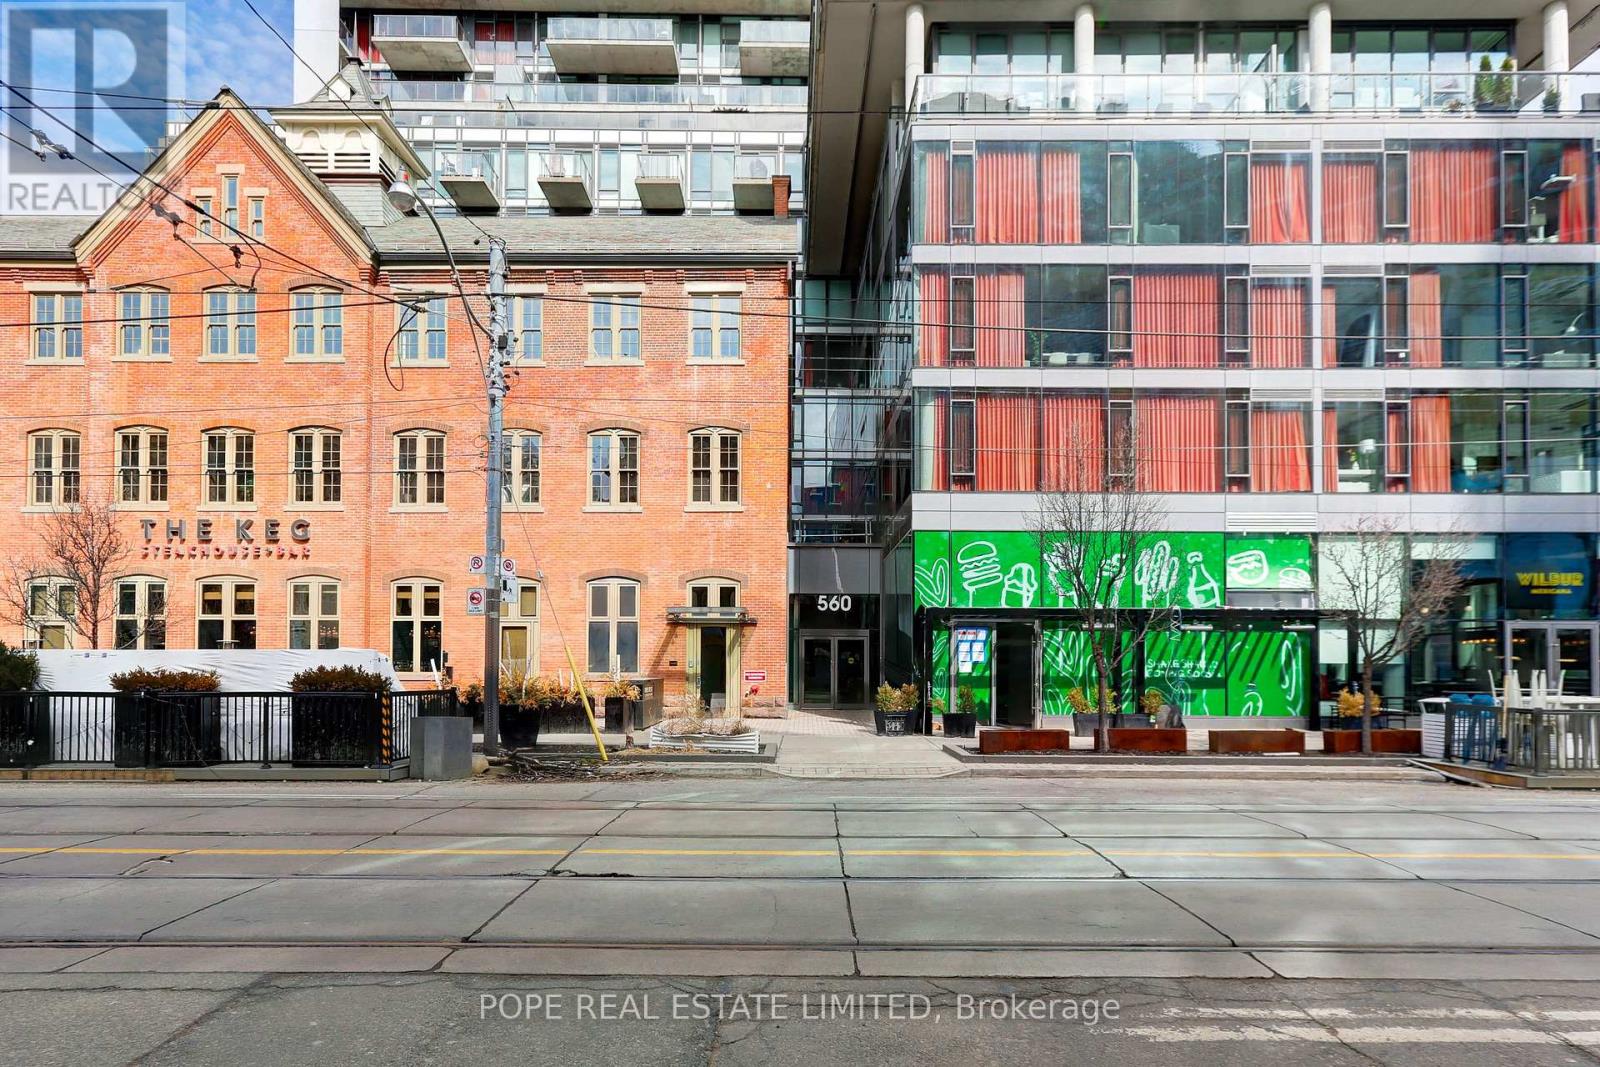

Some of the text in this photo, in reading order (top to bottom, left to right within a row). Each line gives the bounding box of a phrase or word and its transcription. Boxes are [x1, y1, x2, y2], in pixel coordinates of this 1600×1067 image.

[139, 519, 311, 544] THE KEG
[1516, 572, 1585, 586] WILBUR
[817, 595, 852, 612] 560
